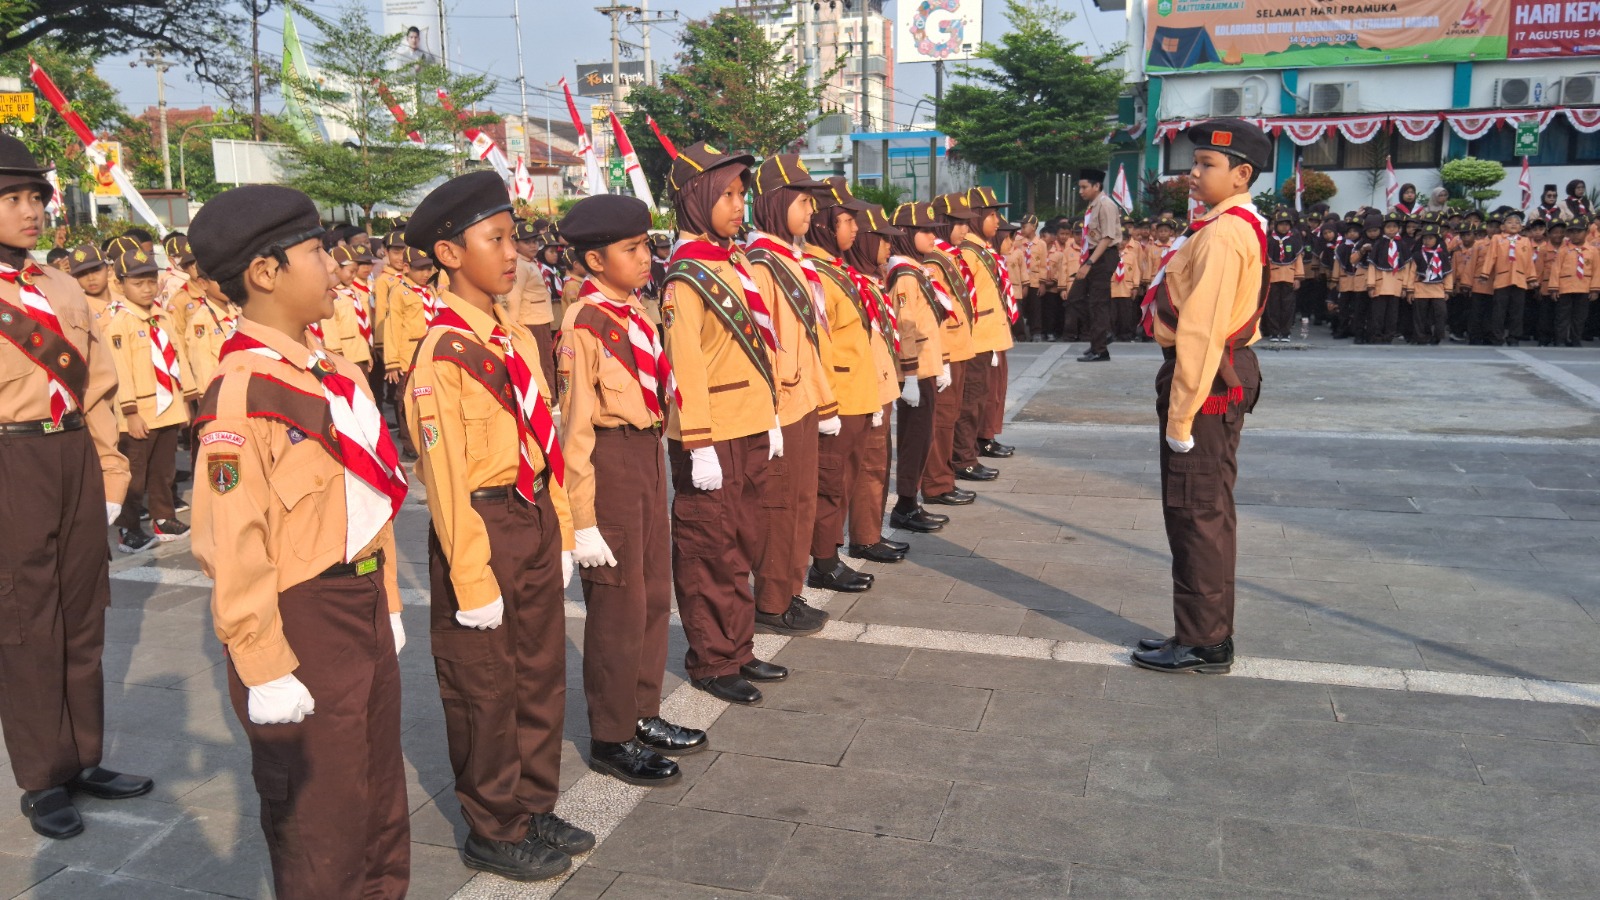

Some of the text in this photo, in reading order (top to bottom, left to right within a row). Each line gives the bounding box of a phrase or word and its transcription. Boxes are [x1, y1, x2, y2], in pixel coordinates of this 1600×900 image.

[1256, 4, 1397, 18] SELAMAT HARI PRAMUKA
[1515, 3, 1561, 25] HARI
[1215, 23, 1265, 36] KOLABORASI
[1267, 22, 1294, 34] UNTUK
[1300, 35, 1333, 44] Agustus
[1335, 34, 1358, 42] 2025
[1515, 32, 1526, 41] 17
[1528, 30, 1580, 40] AGUSTUS
[1534, 82, 1542, 102] AUX
[9, 95, 23, 103] HATI
[17, 104, 29, 112] BRT
